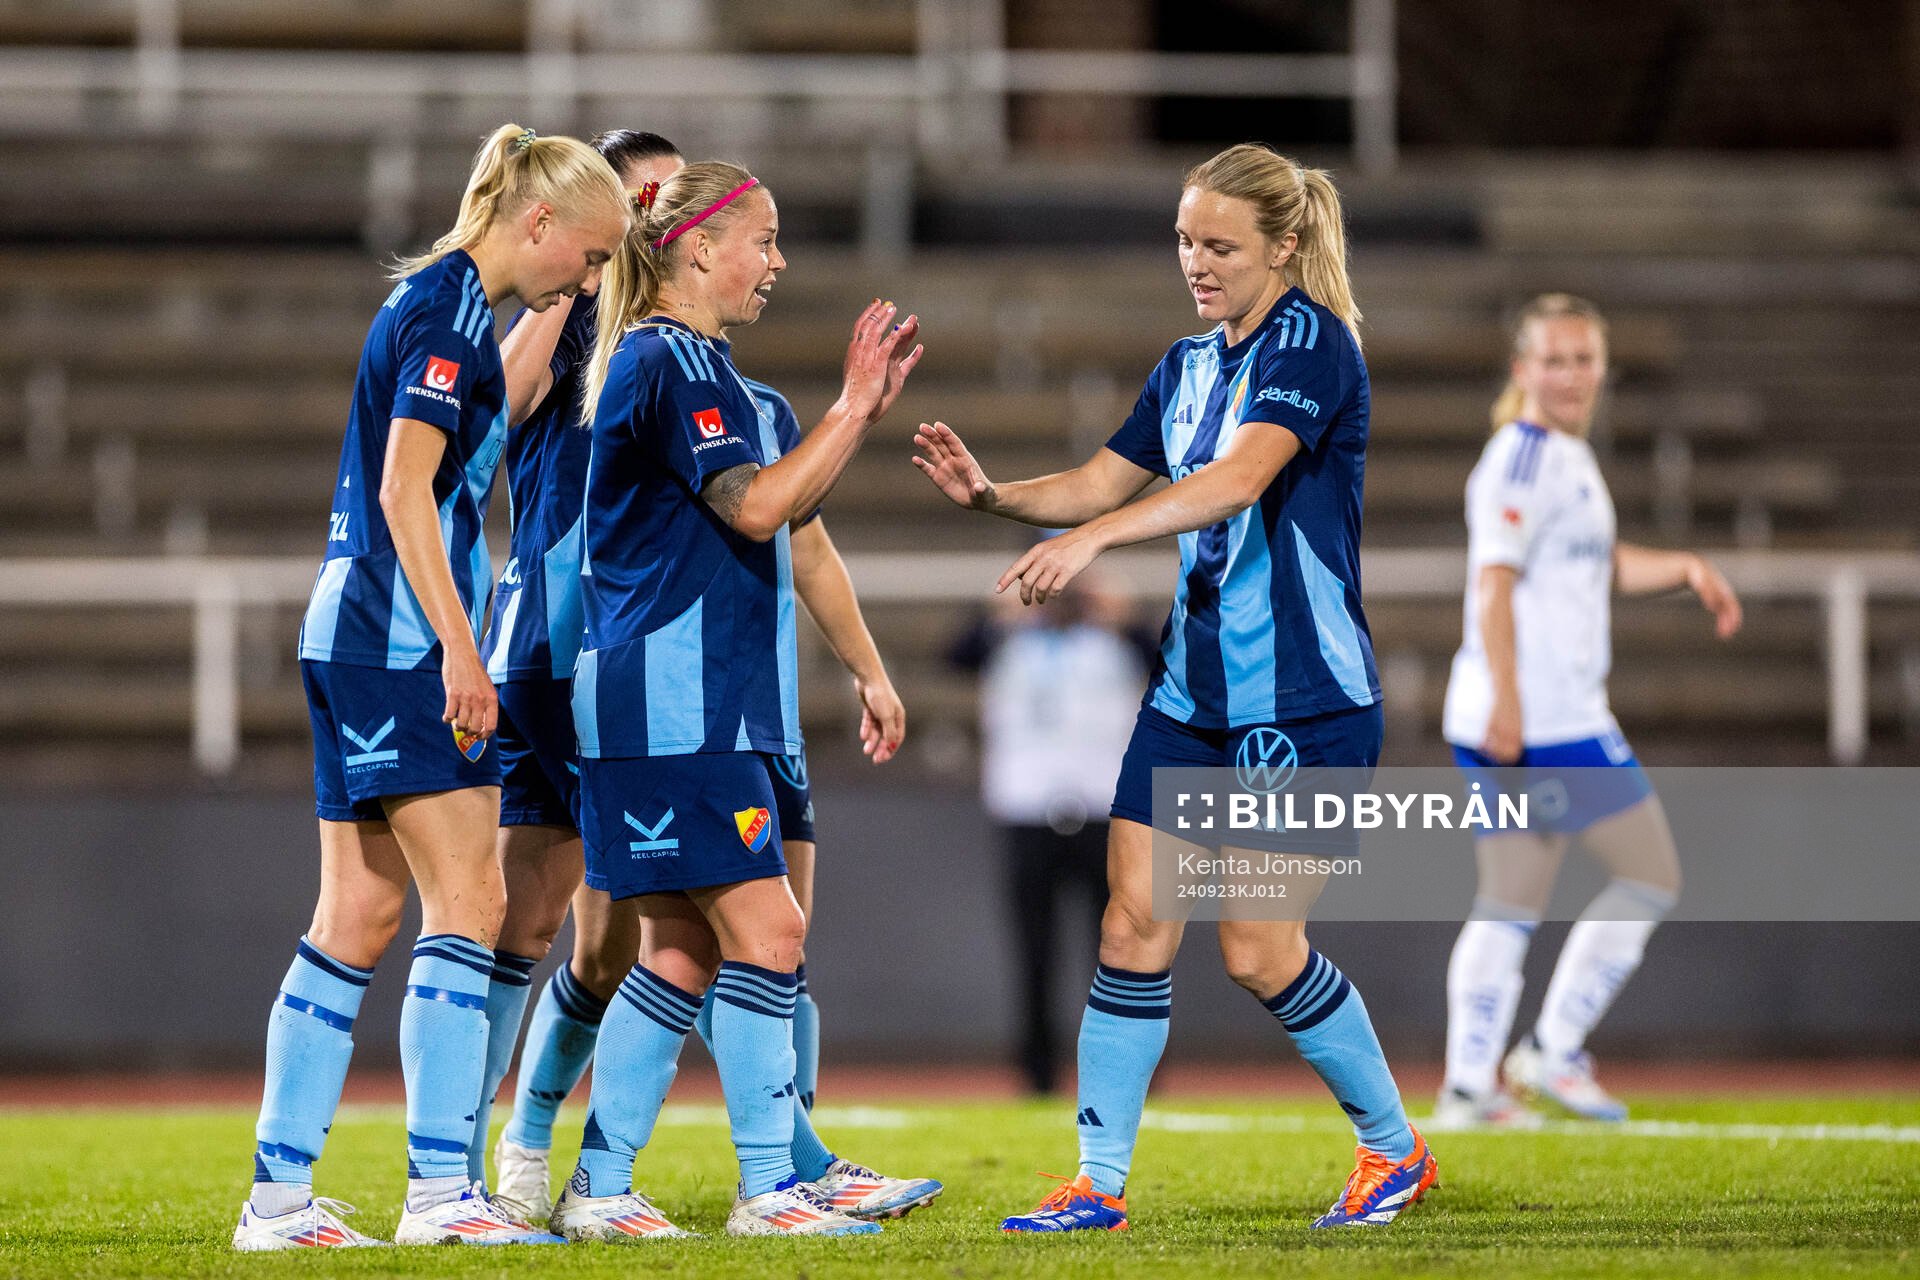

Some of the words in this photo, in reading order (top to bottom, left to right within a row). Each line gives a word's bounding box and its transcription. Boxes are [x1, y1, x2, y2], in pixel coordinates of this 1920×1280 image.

[405, 386, 444, 402] SVENSKA
[1255, 386, 1320, 418] stadium
[693, 438, 728, 454] SVENSKA
[366, 762, 400, 771] CAPITAL
[631, 851, 651, 860] KEEL
